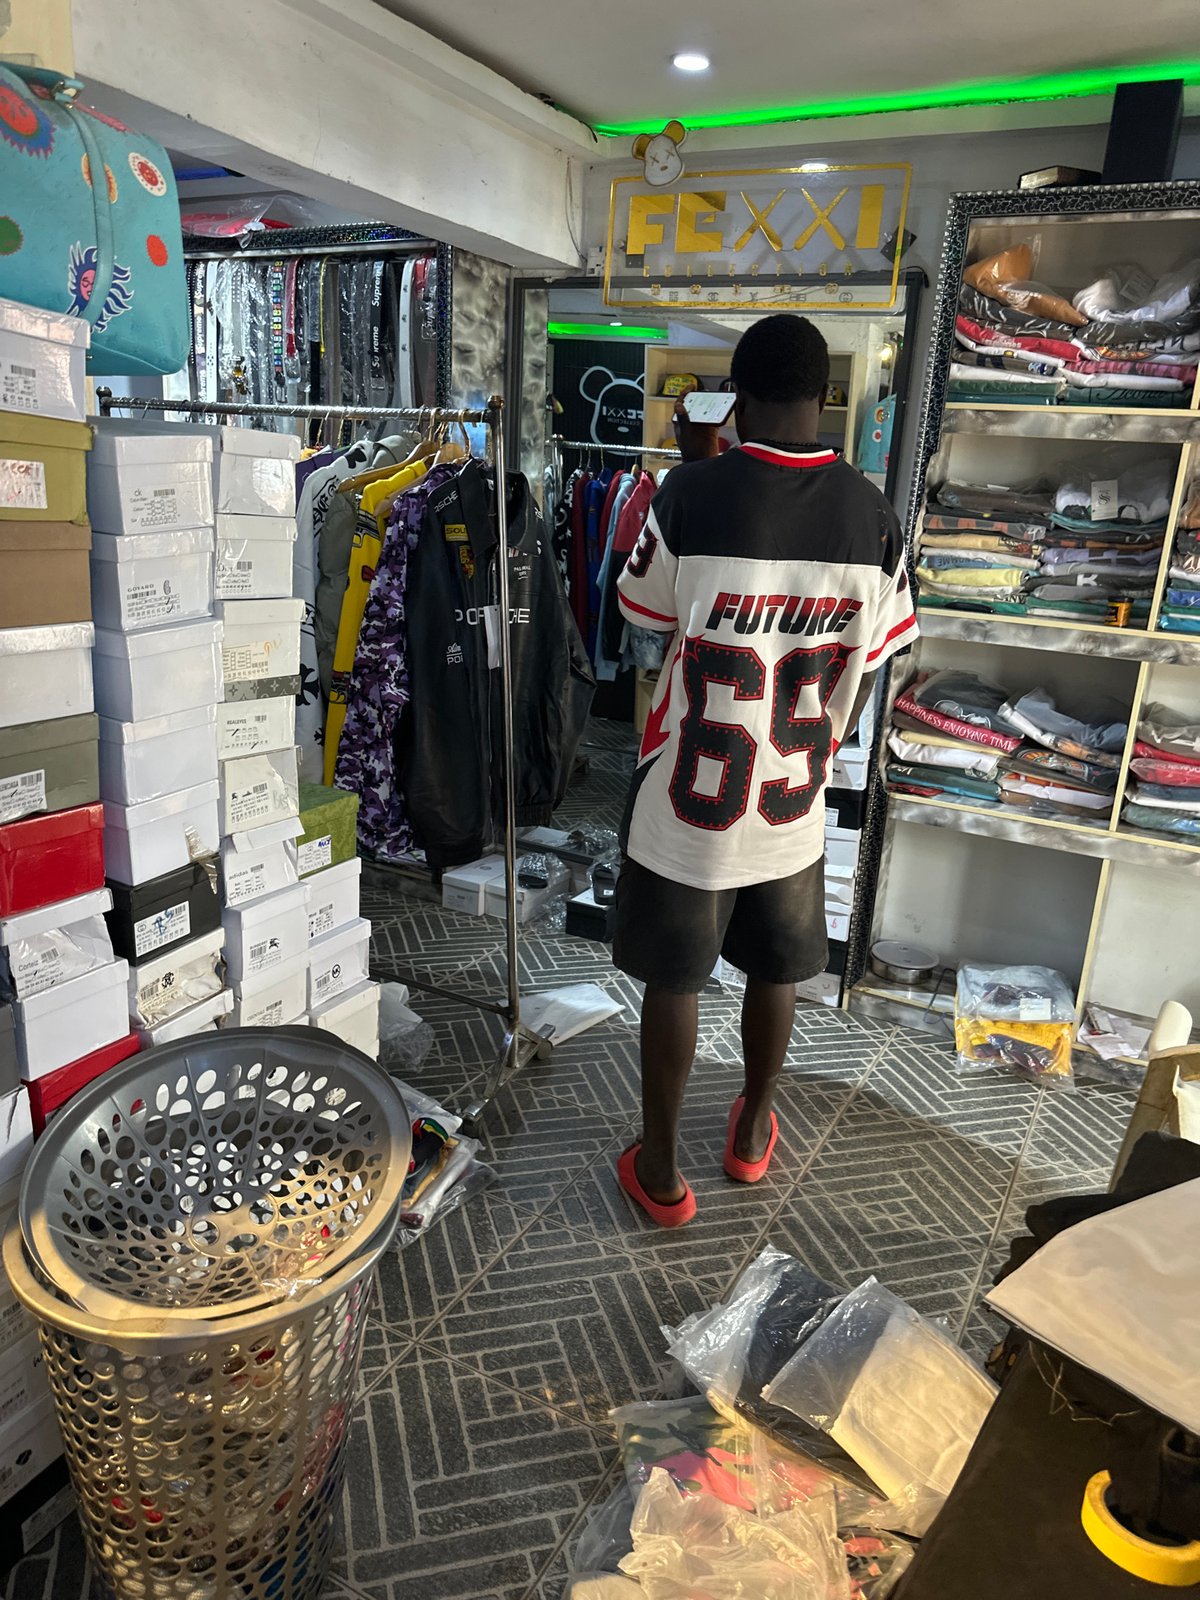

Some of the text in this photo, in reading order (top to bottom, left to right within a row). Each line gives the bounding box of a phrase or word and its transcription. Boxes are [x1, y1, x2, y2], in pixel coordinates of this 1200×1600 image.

[626, 184, 885, 255] FEXXI
[643, 262, 853, 278] COLLECTION
[371, 326, 381, 368] Sureme
[127, 584, 154, 593] GOYARD
[705, 592, 863, 636] FUTURE
[446, 655, 464, 666] PO
[668, 632, 861, 831] 69
[897, 698, 942, 727] HAPPINESS
[942, 721, 987, 744] ENJOYING
